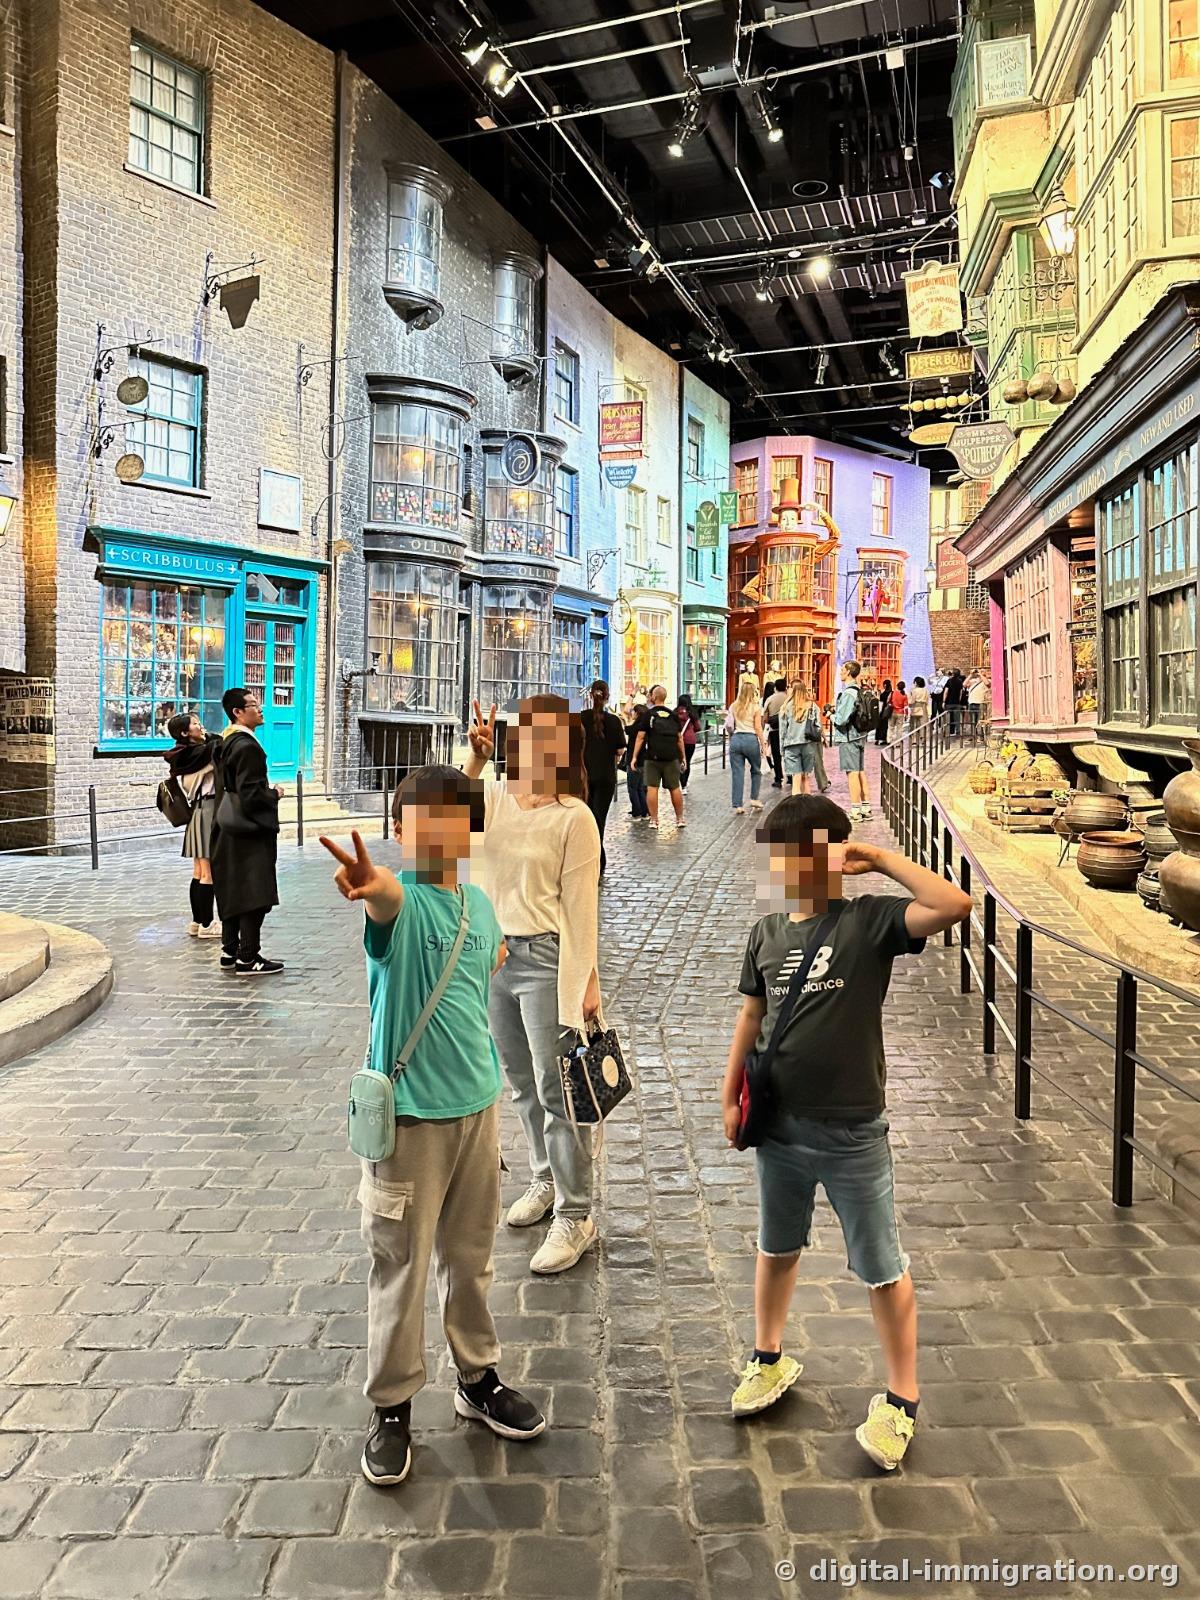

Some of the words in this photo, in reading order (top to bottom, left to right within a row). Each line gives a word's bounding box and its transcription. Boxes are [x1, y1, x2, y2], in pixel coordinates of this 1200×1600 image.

[944, 352, 970, 371] BOAT
[1155, 411, 1173, 437] AND
[1174, 393, 1195, 420] USED
[971, 430, 988, 438] MR.
[120, 548, 225, 573] SCRIBBULUS
[6, 687, 29, 698] WANTED
[29, 685, 52, 697] WANTED
[425, 934, 490, 952] SESID
[770, 986, 790, 996] new
[801, 978, 845, 994] alance
